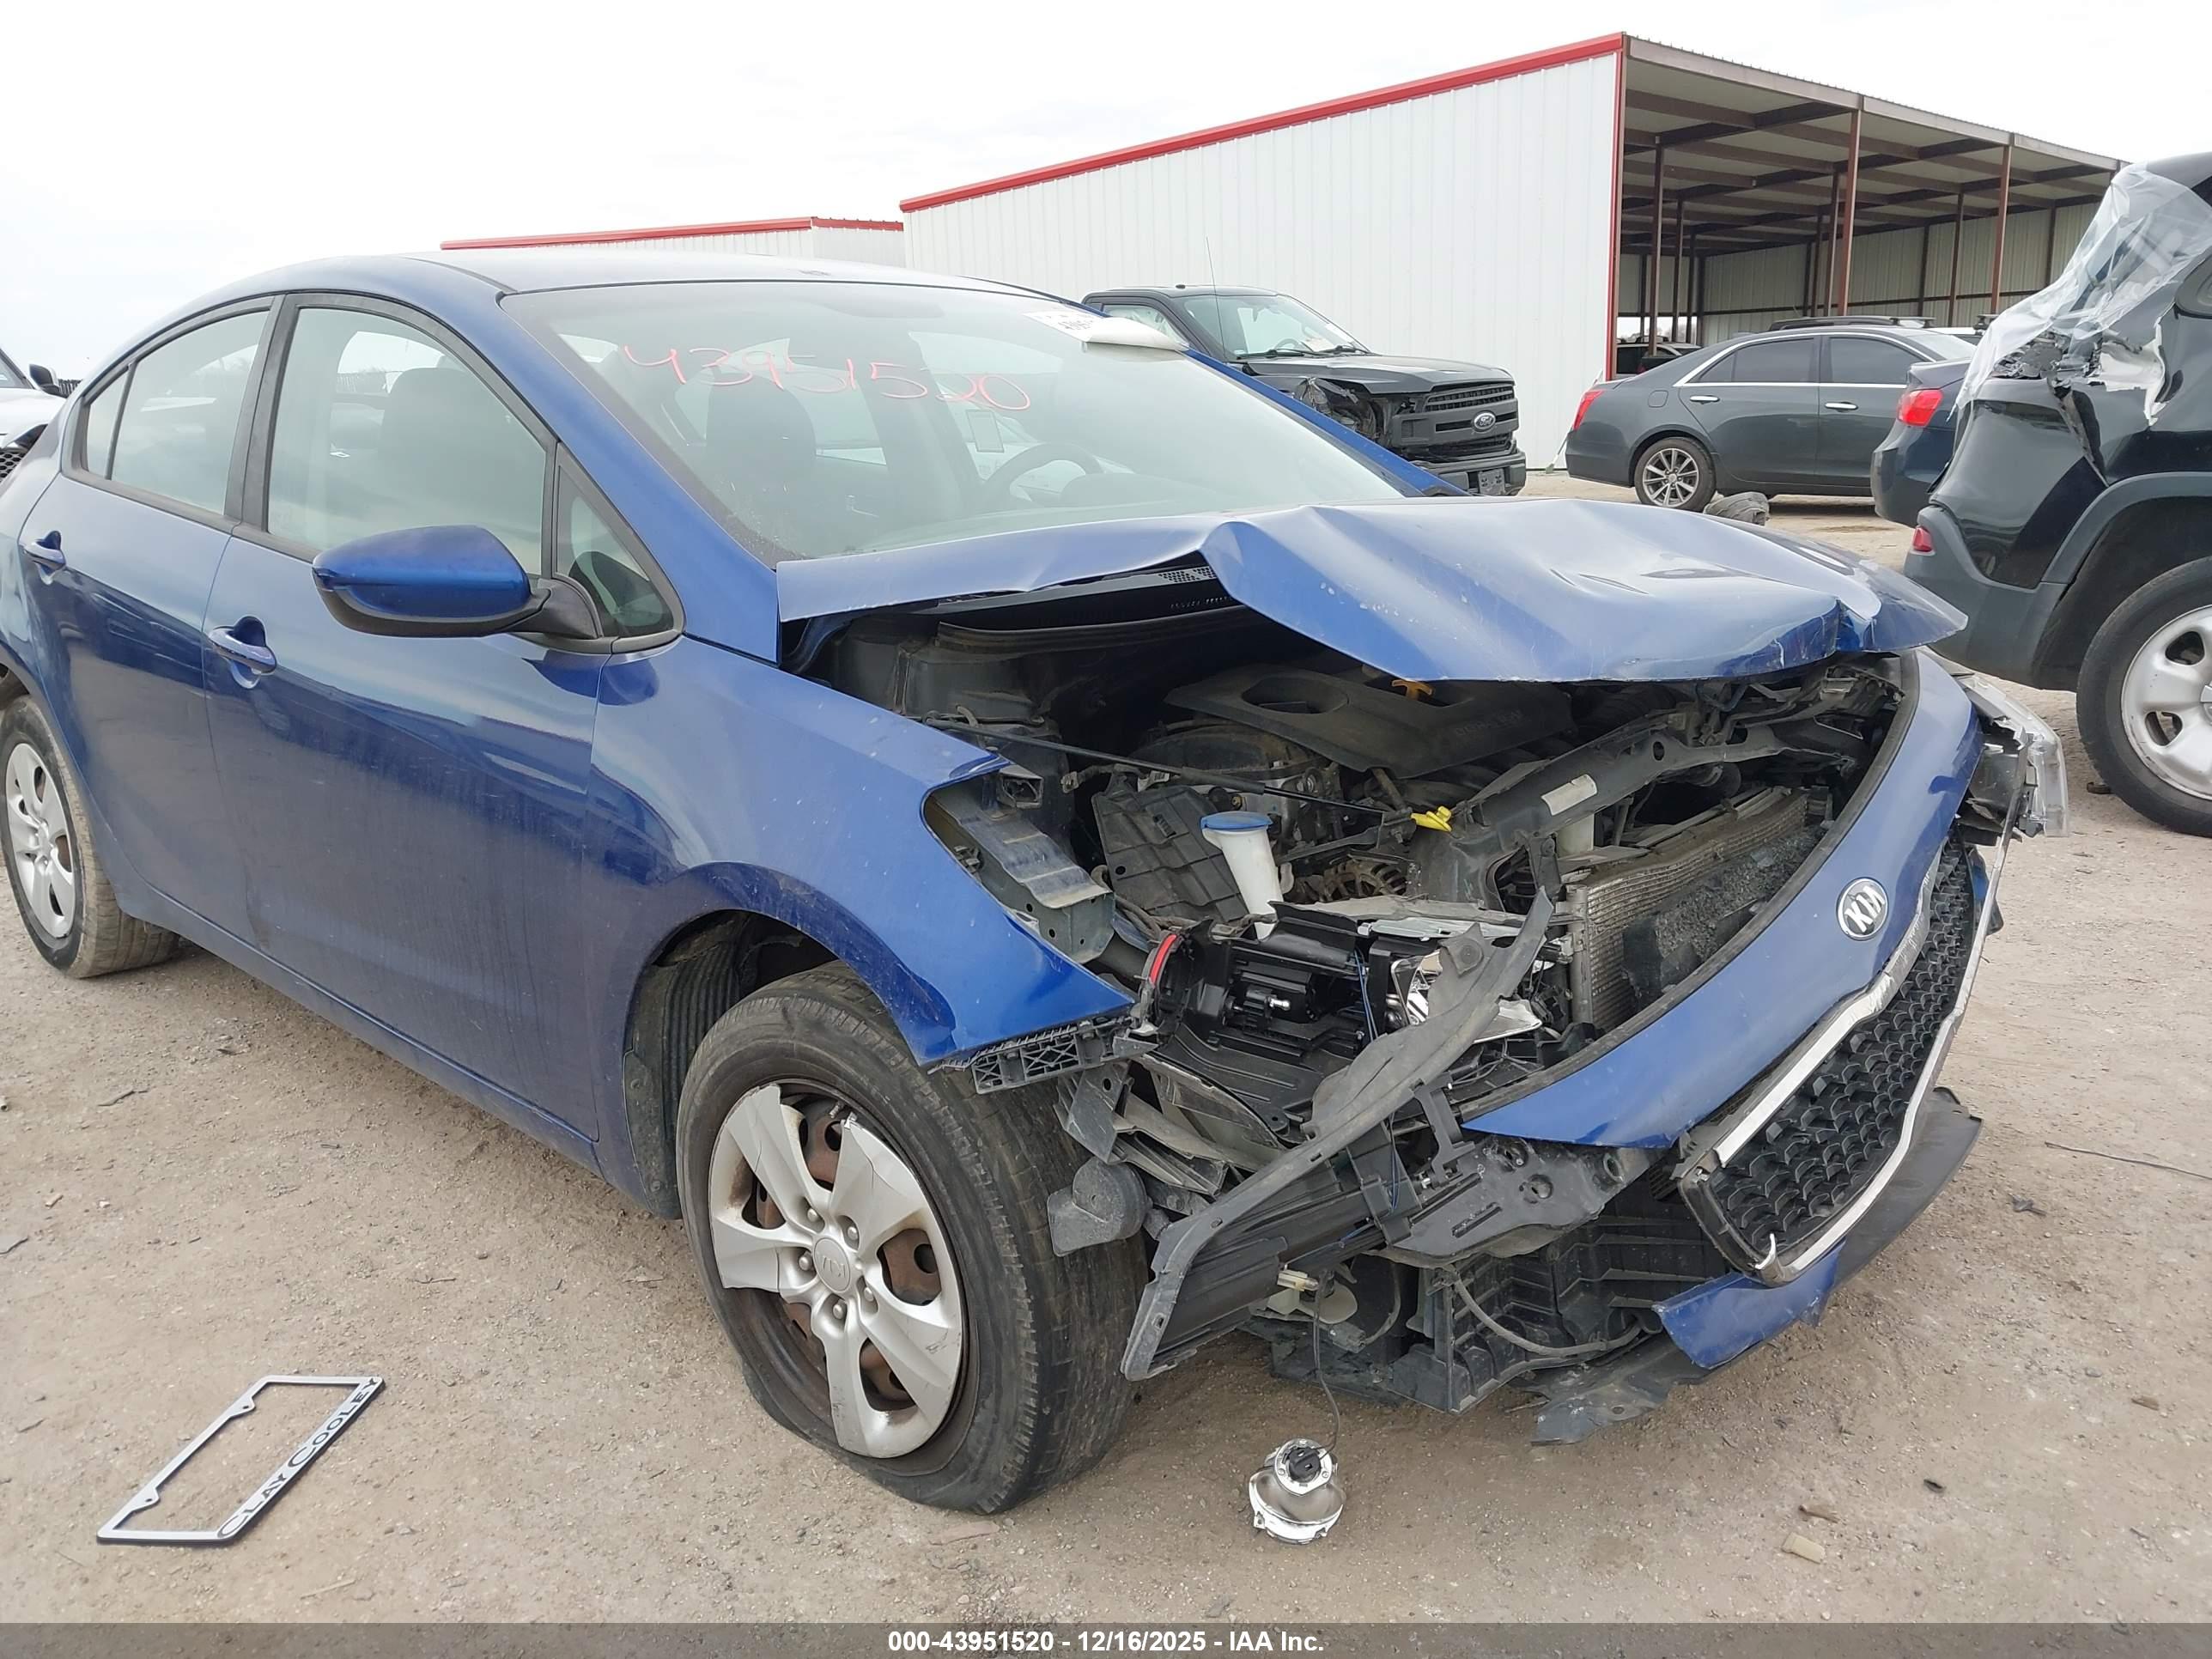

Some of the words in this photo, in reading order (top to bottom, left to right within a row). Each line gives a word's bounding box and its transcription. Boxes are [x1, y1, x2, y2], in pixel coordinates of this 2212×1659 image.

[624, 345, 1030, 410] 43951520
[217, 1474, 287, 1538] CLAY
[288, 1377, 378, 1468] COOLEY
